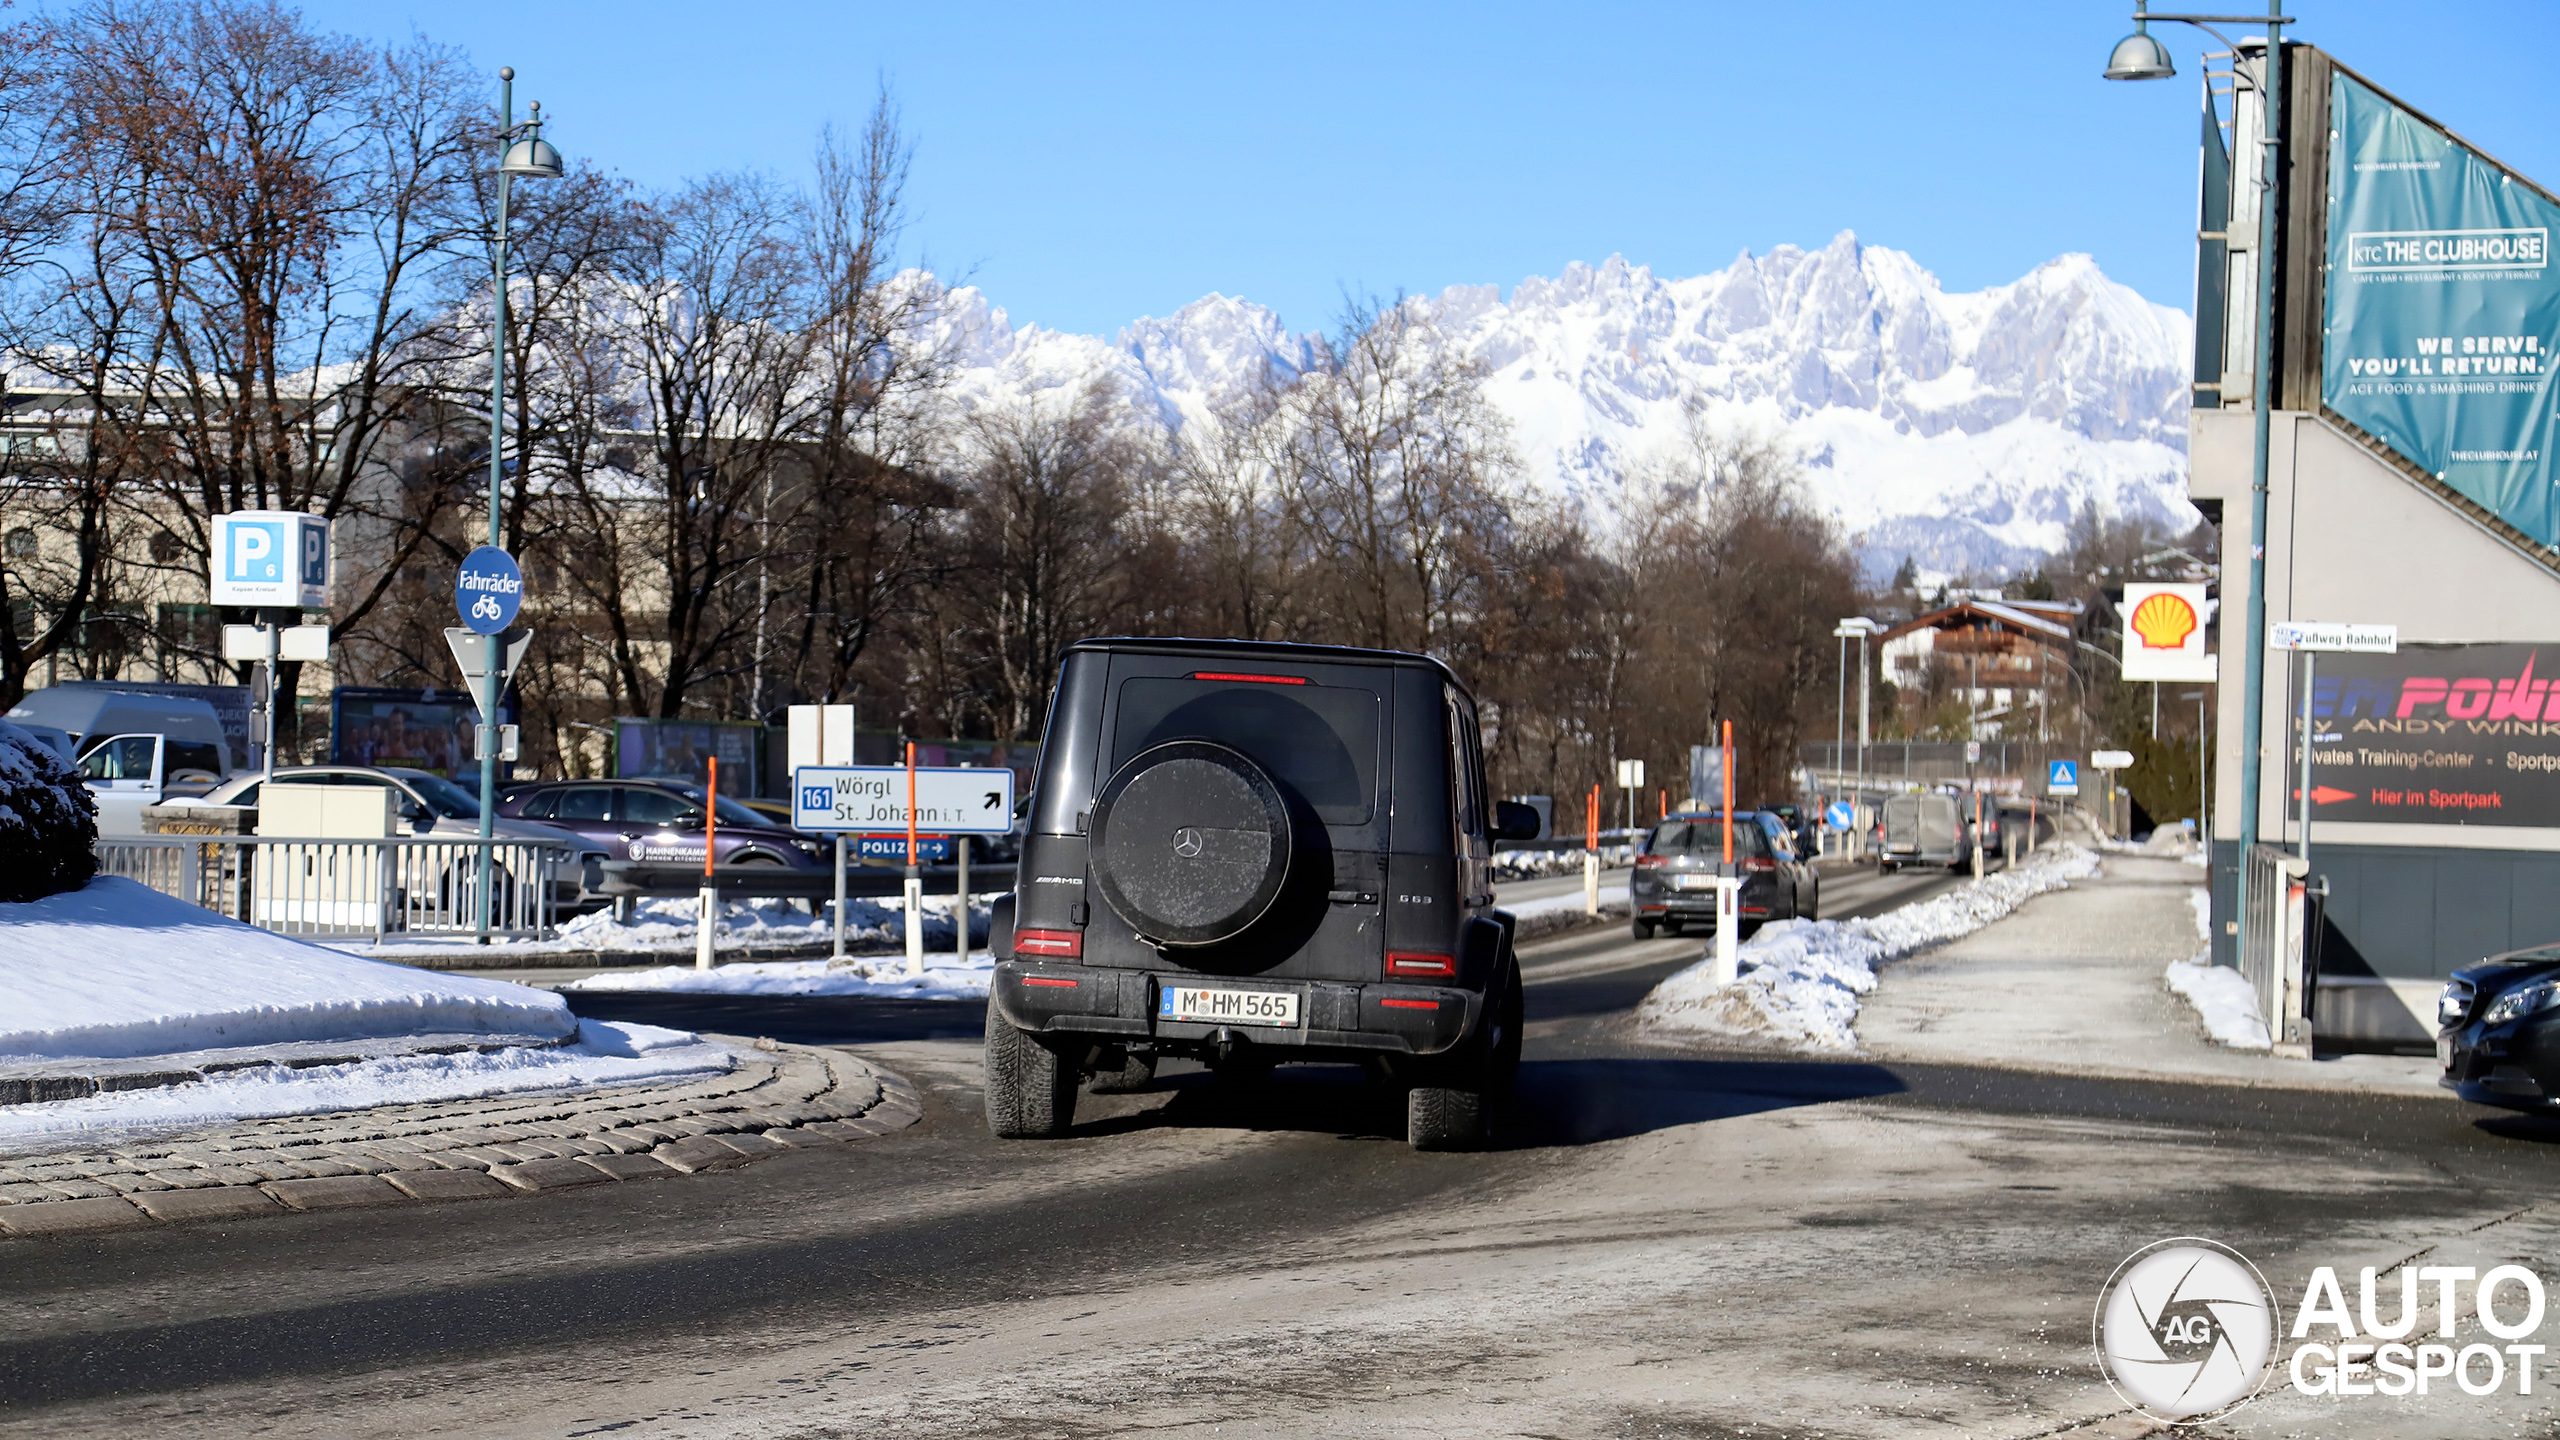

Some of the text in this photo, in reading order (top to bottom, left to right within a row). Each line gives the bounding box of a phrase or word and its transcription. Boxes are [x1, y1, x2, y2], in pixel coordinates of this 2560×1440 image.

[2354, 237, 2542, 263] KTC THE CLUBHOUSE
[2381, 273, 2398, 283] BAR
[2404, 271, 2456, 283] RESTAURANT
[2463, 271, 2503, 281] ROOFTOP
[2505, 269, 2542, 281] TERRACE
[2417, 336, 2546, 357] WE SERVE,
[2348, 356, 2546, 376] YOU'LL RETURN.
[2350, 381, 2544, 396] ACE FOOD & SMASHING DRINKS
[2451, 450, 2539, 461] THECLUBHOUSE.AT
[234, 526, 276, 578] P 6
[305, 529, 320, 579] P
[459, 569, 523, 595] Fahrräder
[2304, 631, 2342, 646] ußweg
[2346, 632, 2393, 646] Bahnhof
[2352, 718, 2455, 735] ANDY
[2295, 746, 2354, 766] Pivates
[2358, 748, 2475, 771] Training-Center
[835, 776, 891, 799] Wörgl
[803, 788, 832, 809] 161
[2371, 787, 2503, 811] Hier im Sportpark
[834, 802, 966, 822] St. Johann i. T.
[861, 841, 920, 855] POLIZI
[1164, 1002, 1171, 1011] D
[1182, 991, 1198, 1013] M
